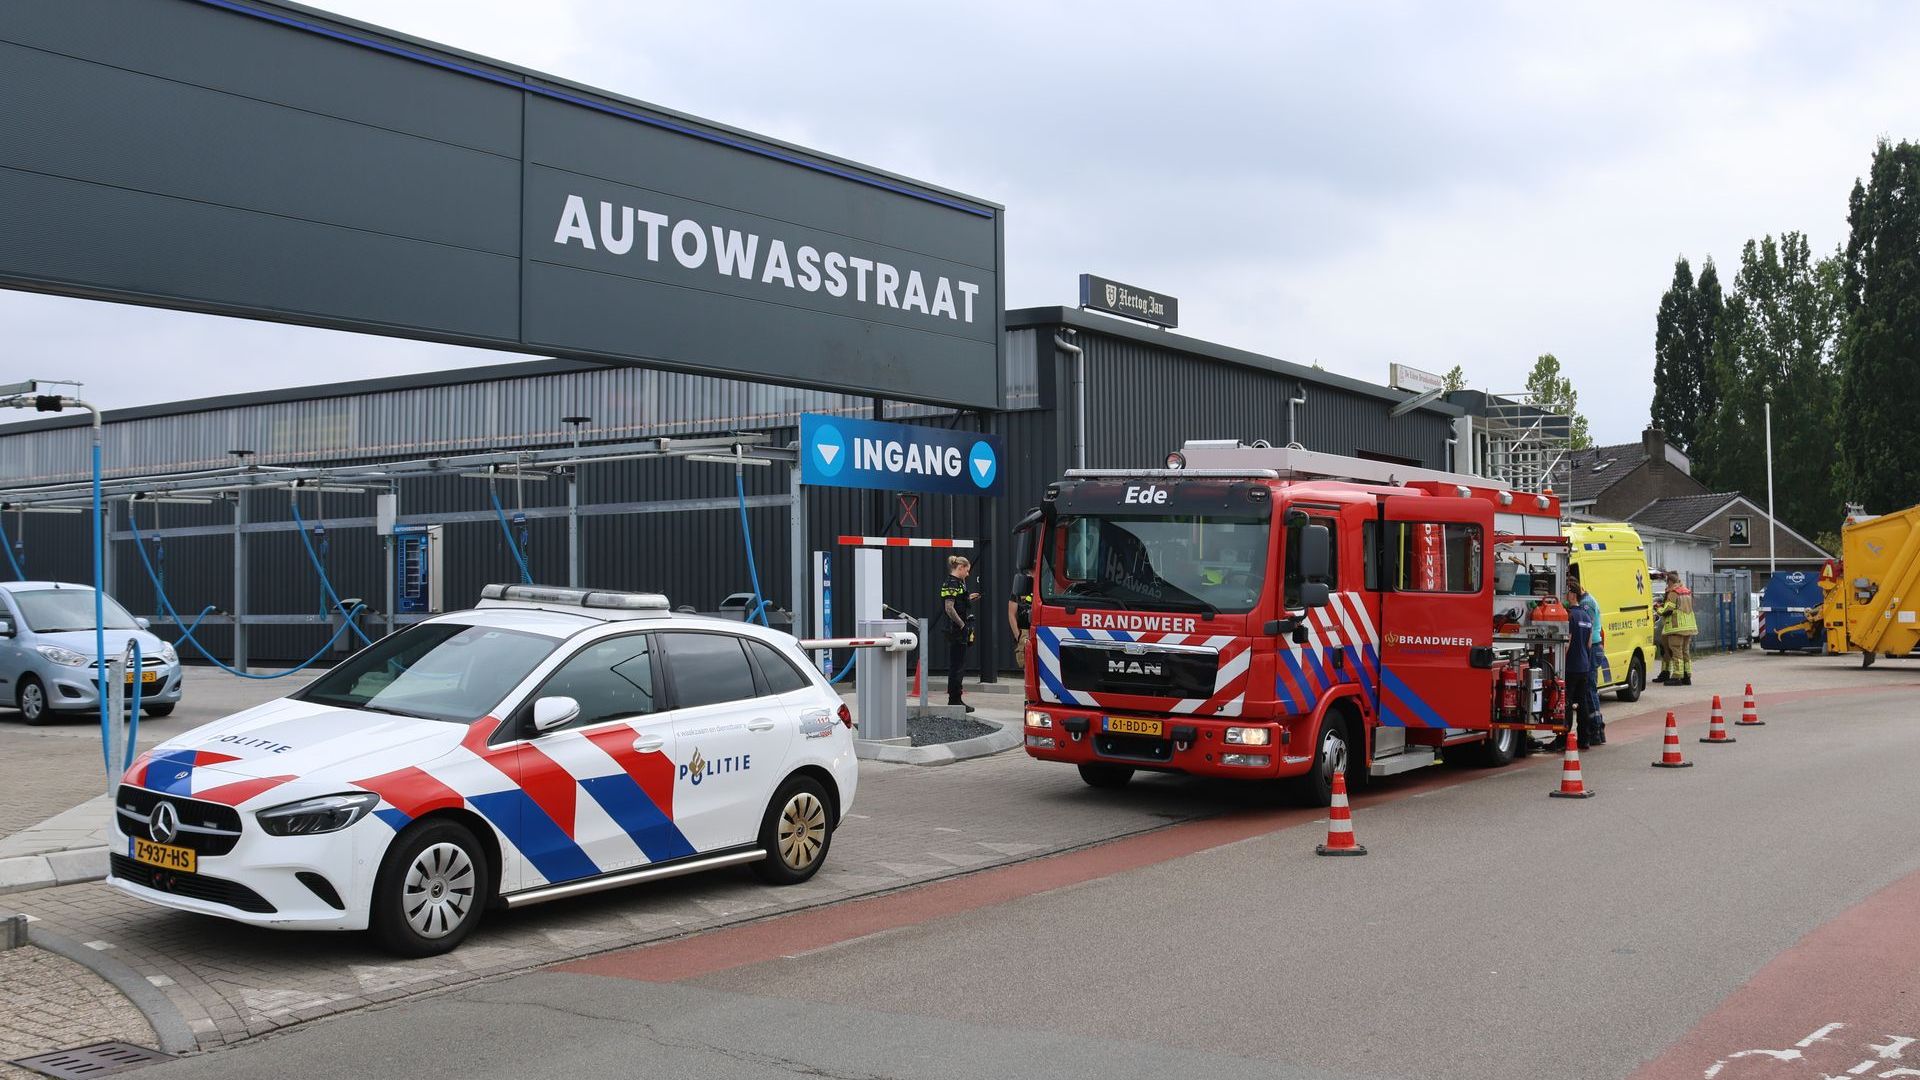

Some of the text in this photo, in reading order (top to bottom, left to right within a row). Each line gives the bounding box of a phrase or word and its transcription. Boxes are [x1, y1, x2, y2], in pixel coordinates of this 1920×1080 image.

[554, 194, 980, 323] AUTOWASSTRAAT
[1119, 288, 1164, 317] Hertog Jan
[854, 437, 962, 477] INGANG
[1125, 485, 1168, 504] Ede
[1081, 613, 1196, 632] BRANDWEER
[1399, 635, 1473, 646] BRANDWEER
[1108, 660, 1162, 676] MAN
[1112, 719, 1159, 733] 61-BDD-9
[207, 734, 292, 754] POLITIE
[680, 754, 751, 786] POLITIE
[137, 841, 189, 868] Z-937-HS
